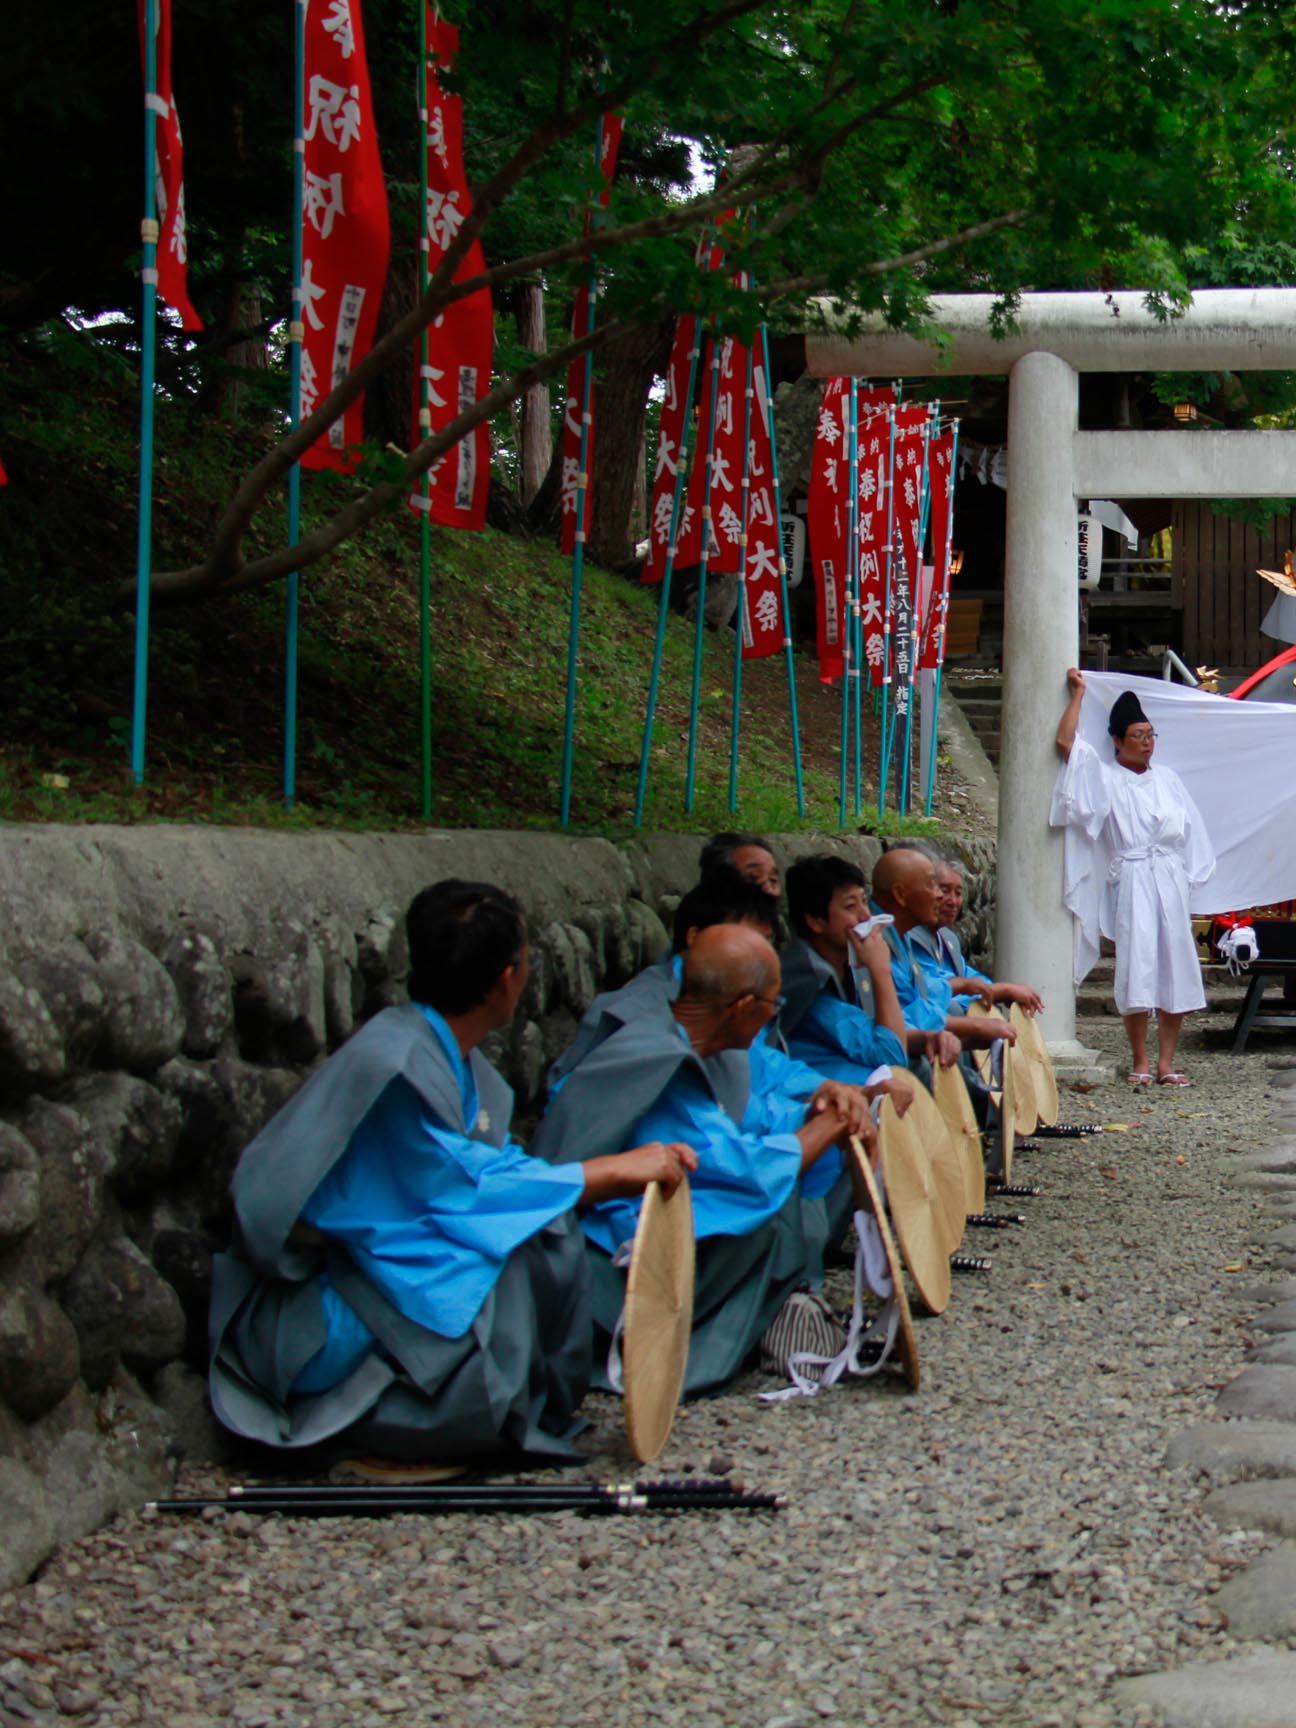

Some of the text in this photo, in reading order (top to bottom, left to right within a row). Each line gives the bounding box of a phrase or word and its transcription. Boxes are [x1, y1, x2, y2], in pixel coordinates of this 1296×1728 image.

[858, 468, 885, 667] 奉祝例大祭
